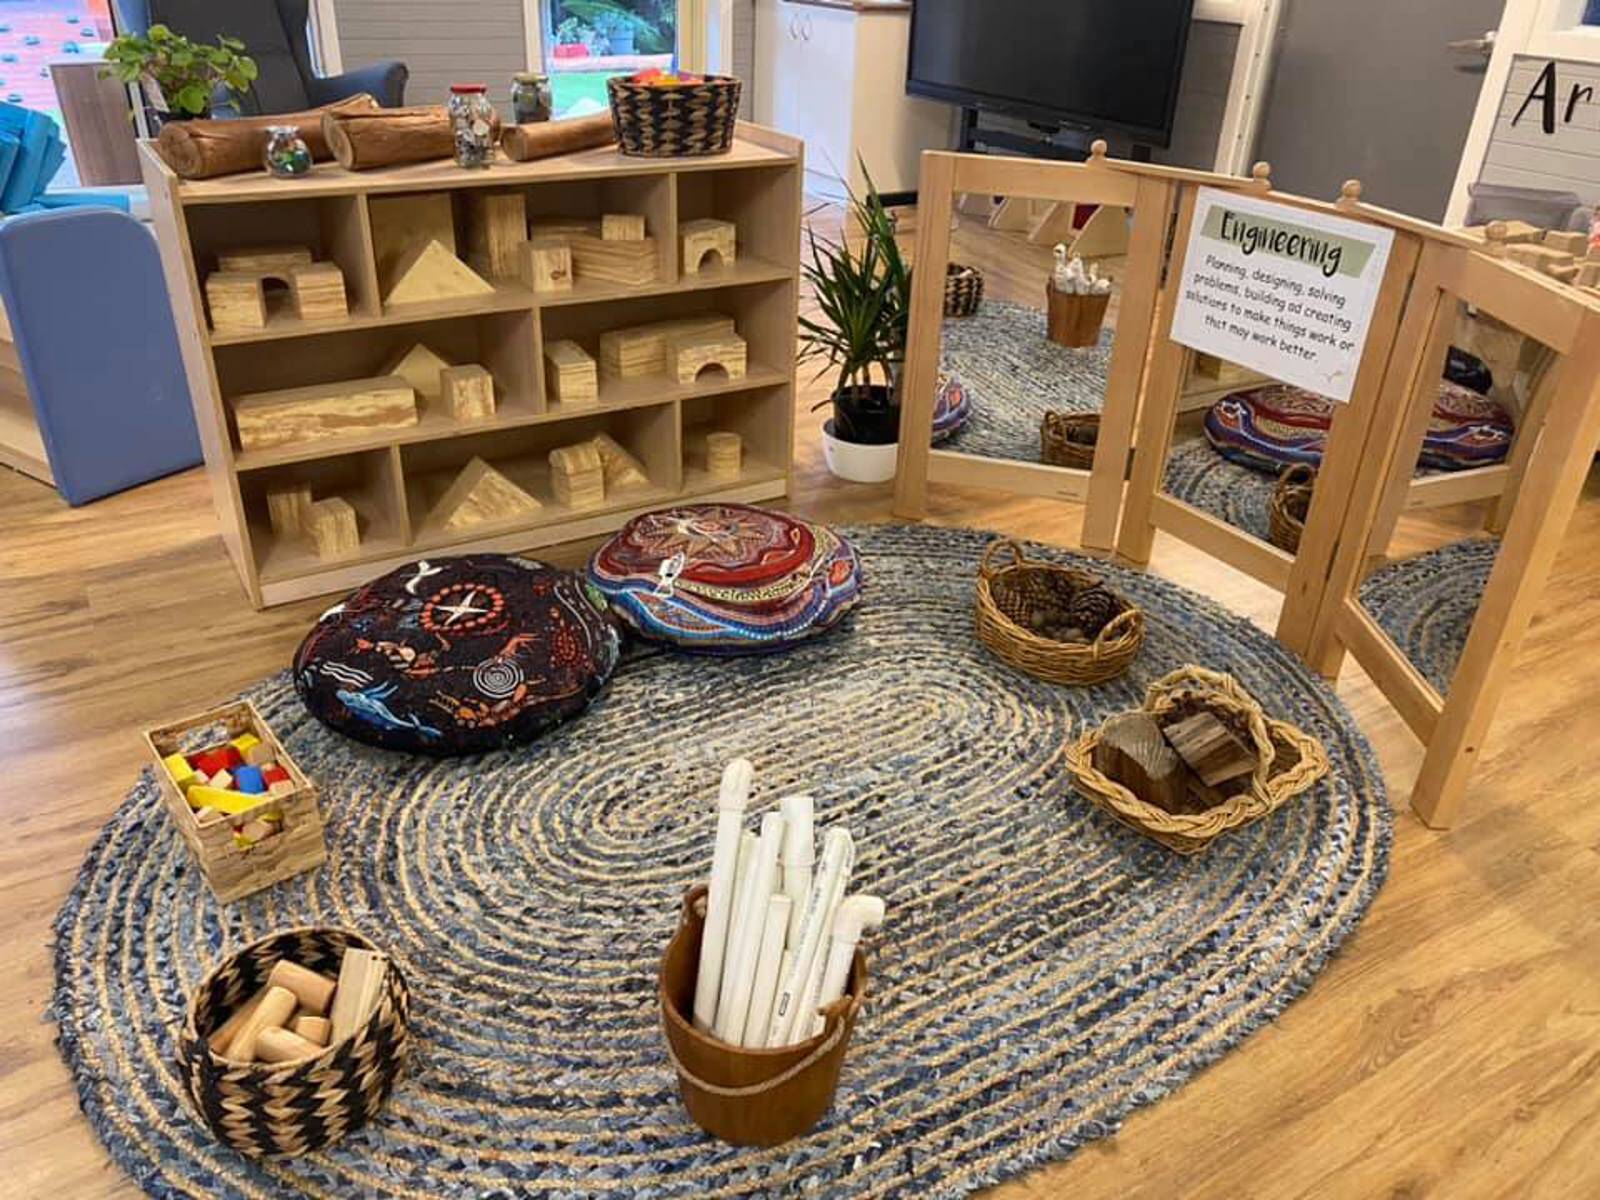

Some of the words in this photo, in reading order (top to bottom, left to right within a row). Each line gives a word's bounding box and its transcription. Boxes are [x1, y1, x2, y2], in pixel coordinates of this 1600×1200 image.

[1220, 211, 1342, 277] Engineering
[1186, 290, 1228, 312] solutions
[1230, 303, 1242, 316] to
[1243, 308, 1271, 325] make
[1274, 316, 1308, 339] things
[1309, 331, 1336, 347] work
[1339, 340, 1355, 351] or
[1244, 286, 1286, 312] building
[1287, 302, 1303, 315] ad
[1304, 307, 1352, 333] creating
[1307, 286, 1346, 310] solving
[1205, 314, 1227, 330] that
[1229, 323, 1250, 340] may
[1252, 332, 1277, 347] work
